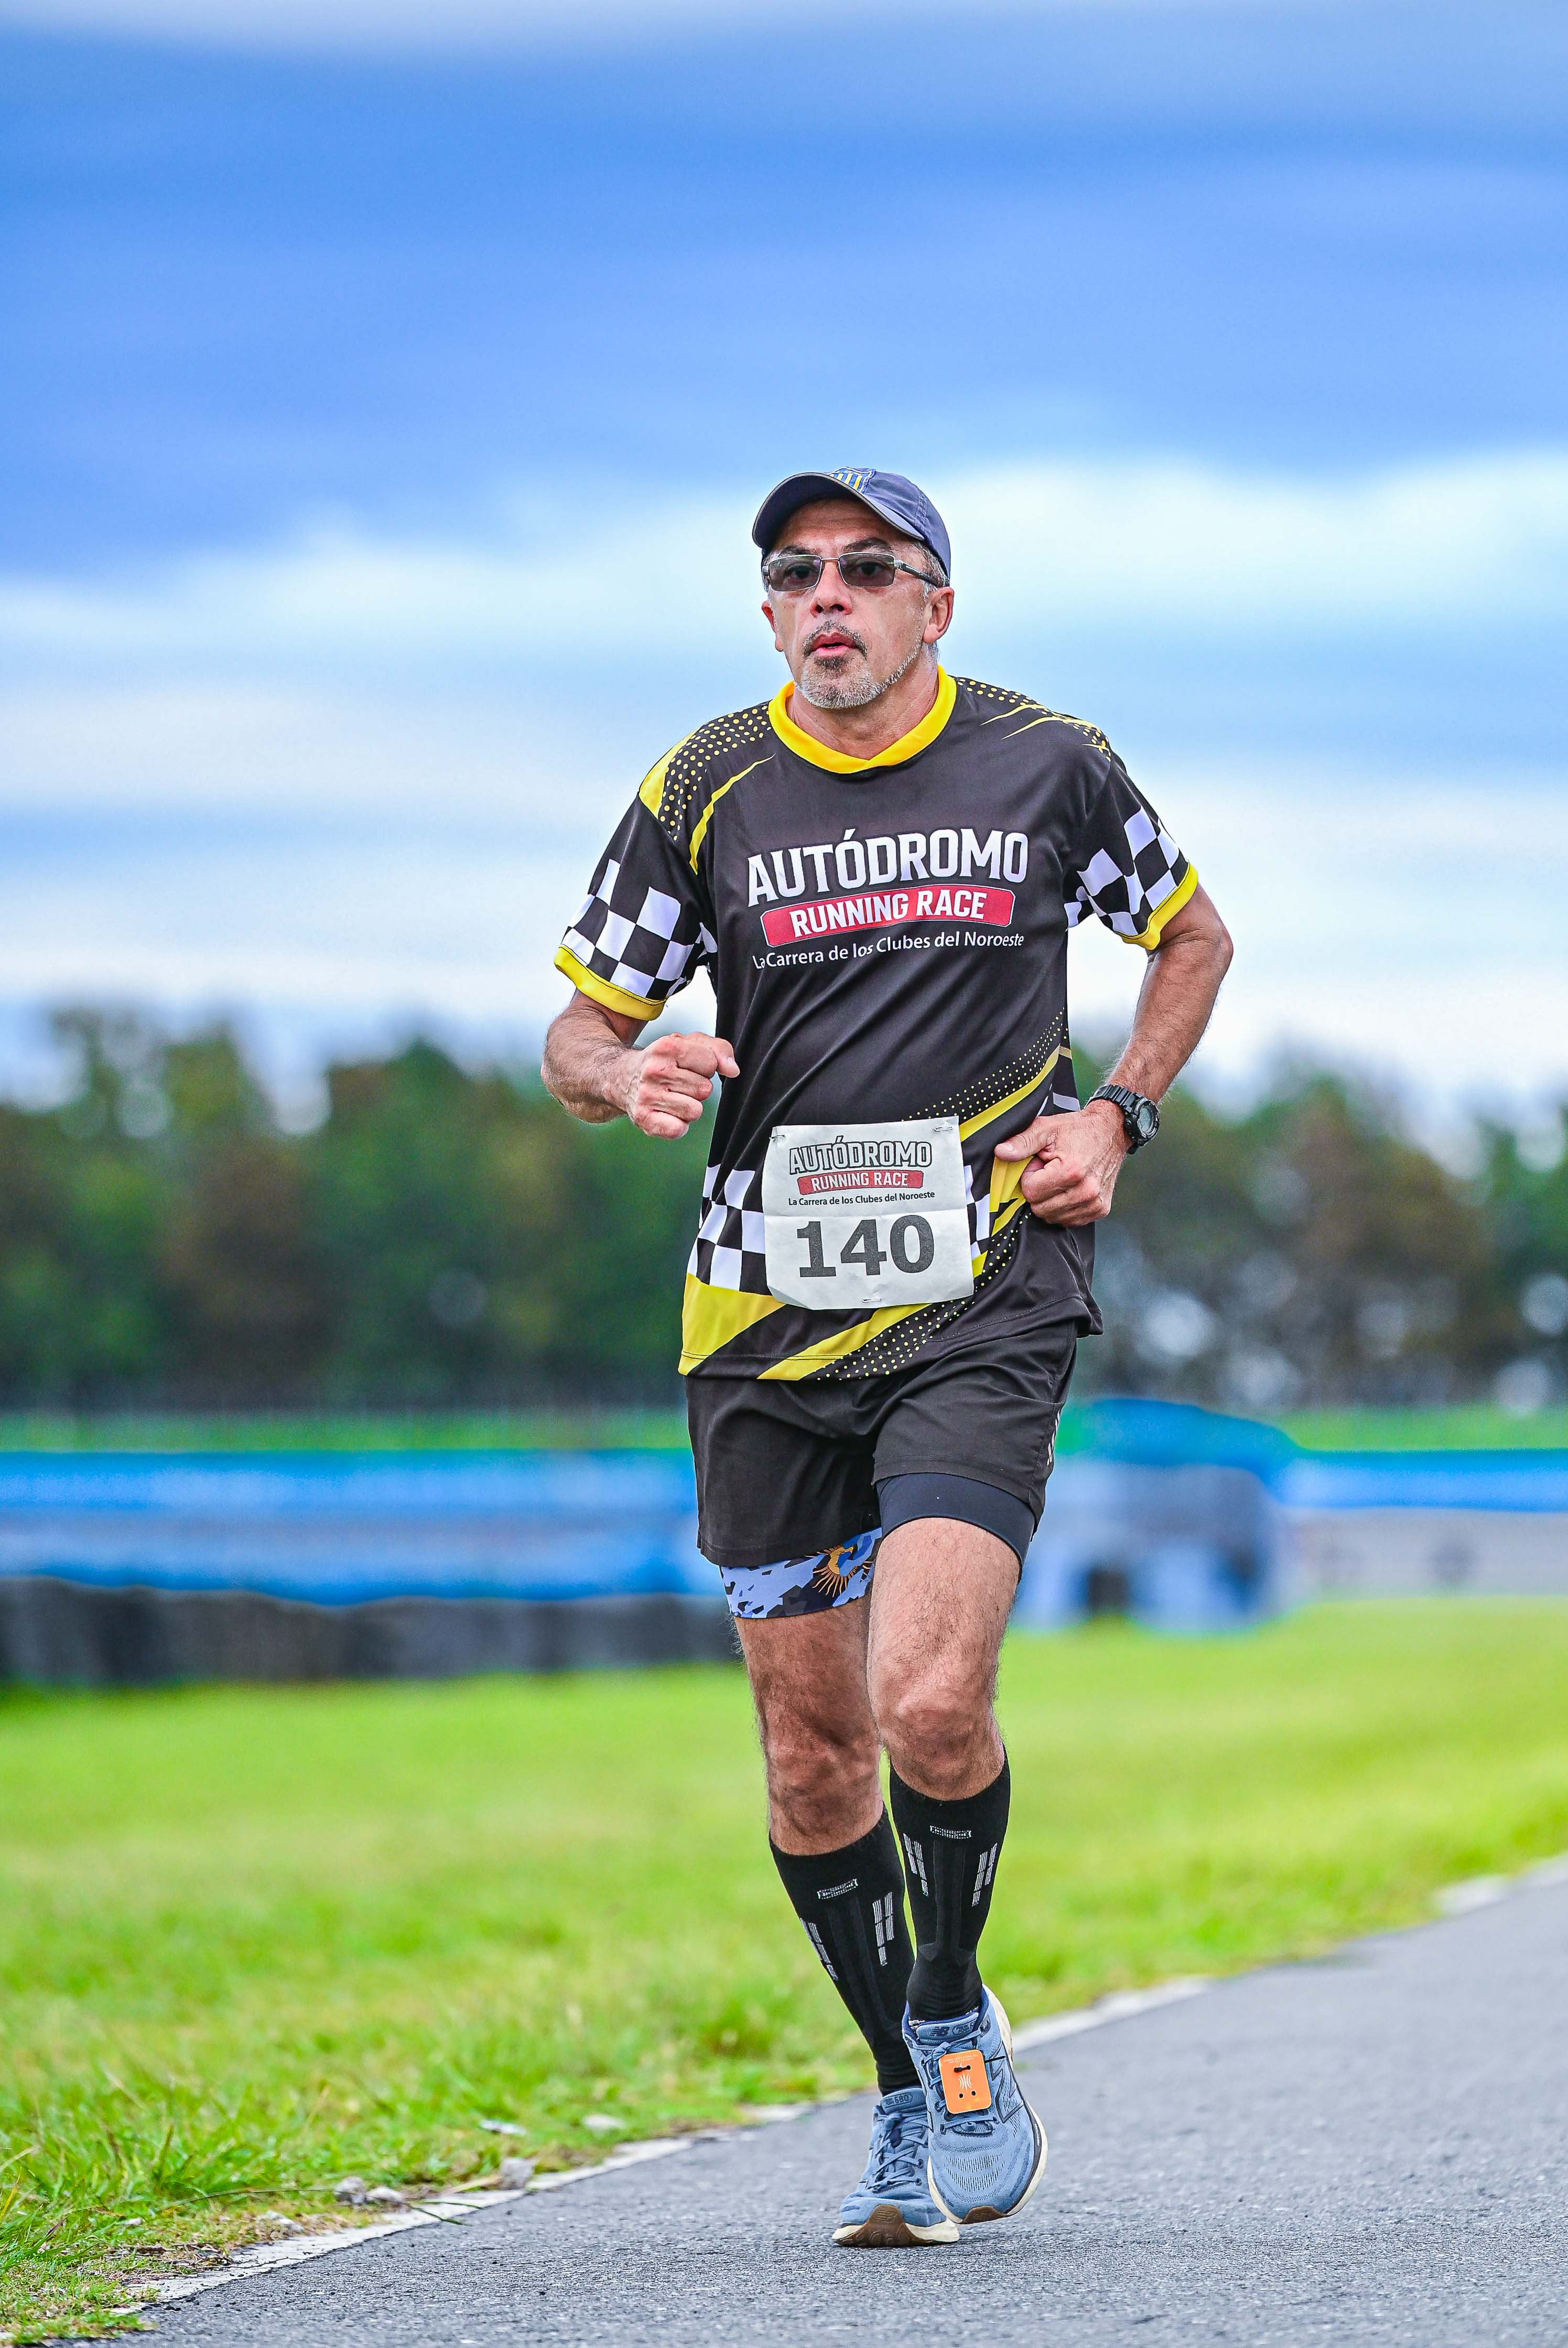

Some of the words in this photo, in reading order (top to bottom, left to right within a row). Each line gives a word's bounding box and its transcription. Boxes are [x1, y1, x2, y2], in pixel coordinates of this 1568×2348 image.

[747, 828, 1029, 907] AUTÓDROMO
[789, 895, 909, 938] RUNNING
[916, 889, 988, 920] RACE
[752, 955, 765, 969] La
[766, 950, 824, 967] Carrera
[828, 945, 849, 961] de
[852, 943, 873, 958] los
[876, 935, 931, 952] Clubes
[934, 931, 960, 947] del
[964, 931, 1024, 947] Noroeste
[789, 1135, 932, 1175] AUTÓDROMO
[788, 1198, 797, 1206] La
[829, 1197, 840, 1205] de
[841, 1194, 853, 1204] los
[855, 1195, 883, 1204] Clubes
[884, 1193, 897, 1203] del
[899, 1191, 935, 1202] Noroeste
[810, 1172, 870, 1192] RUNNING
[873, 1172, 909, 1187] RACE
[796, 1215, 934, 1278] 140
